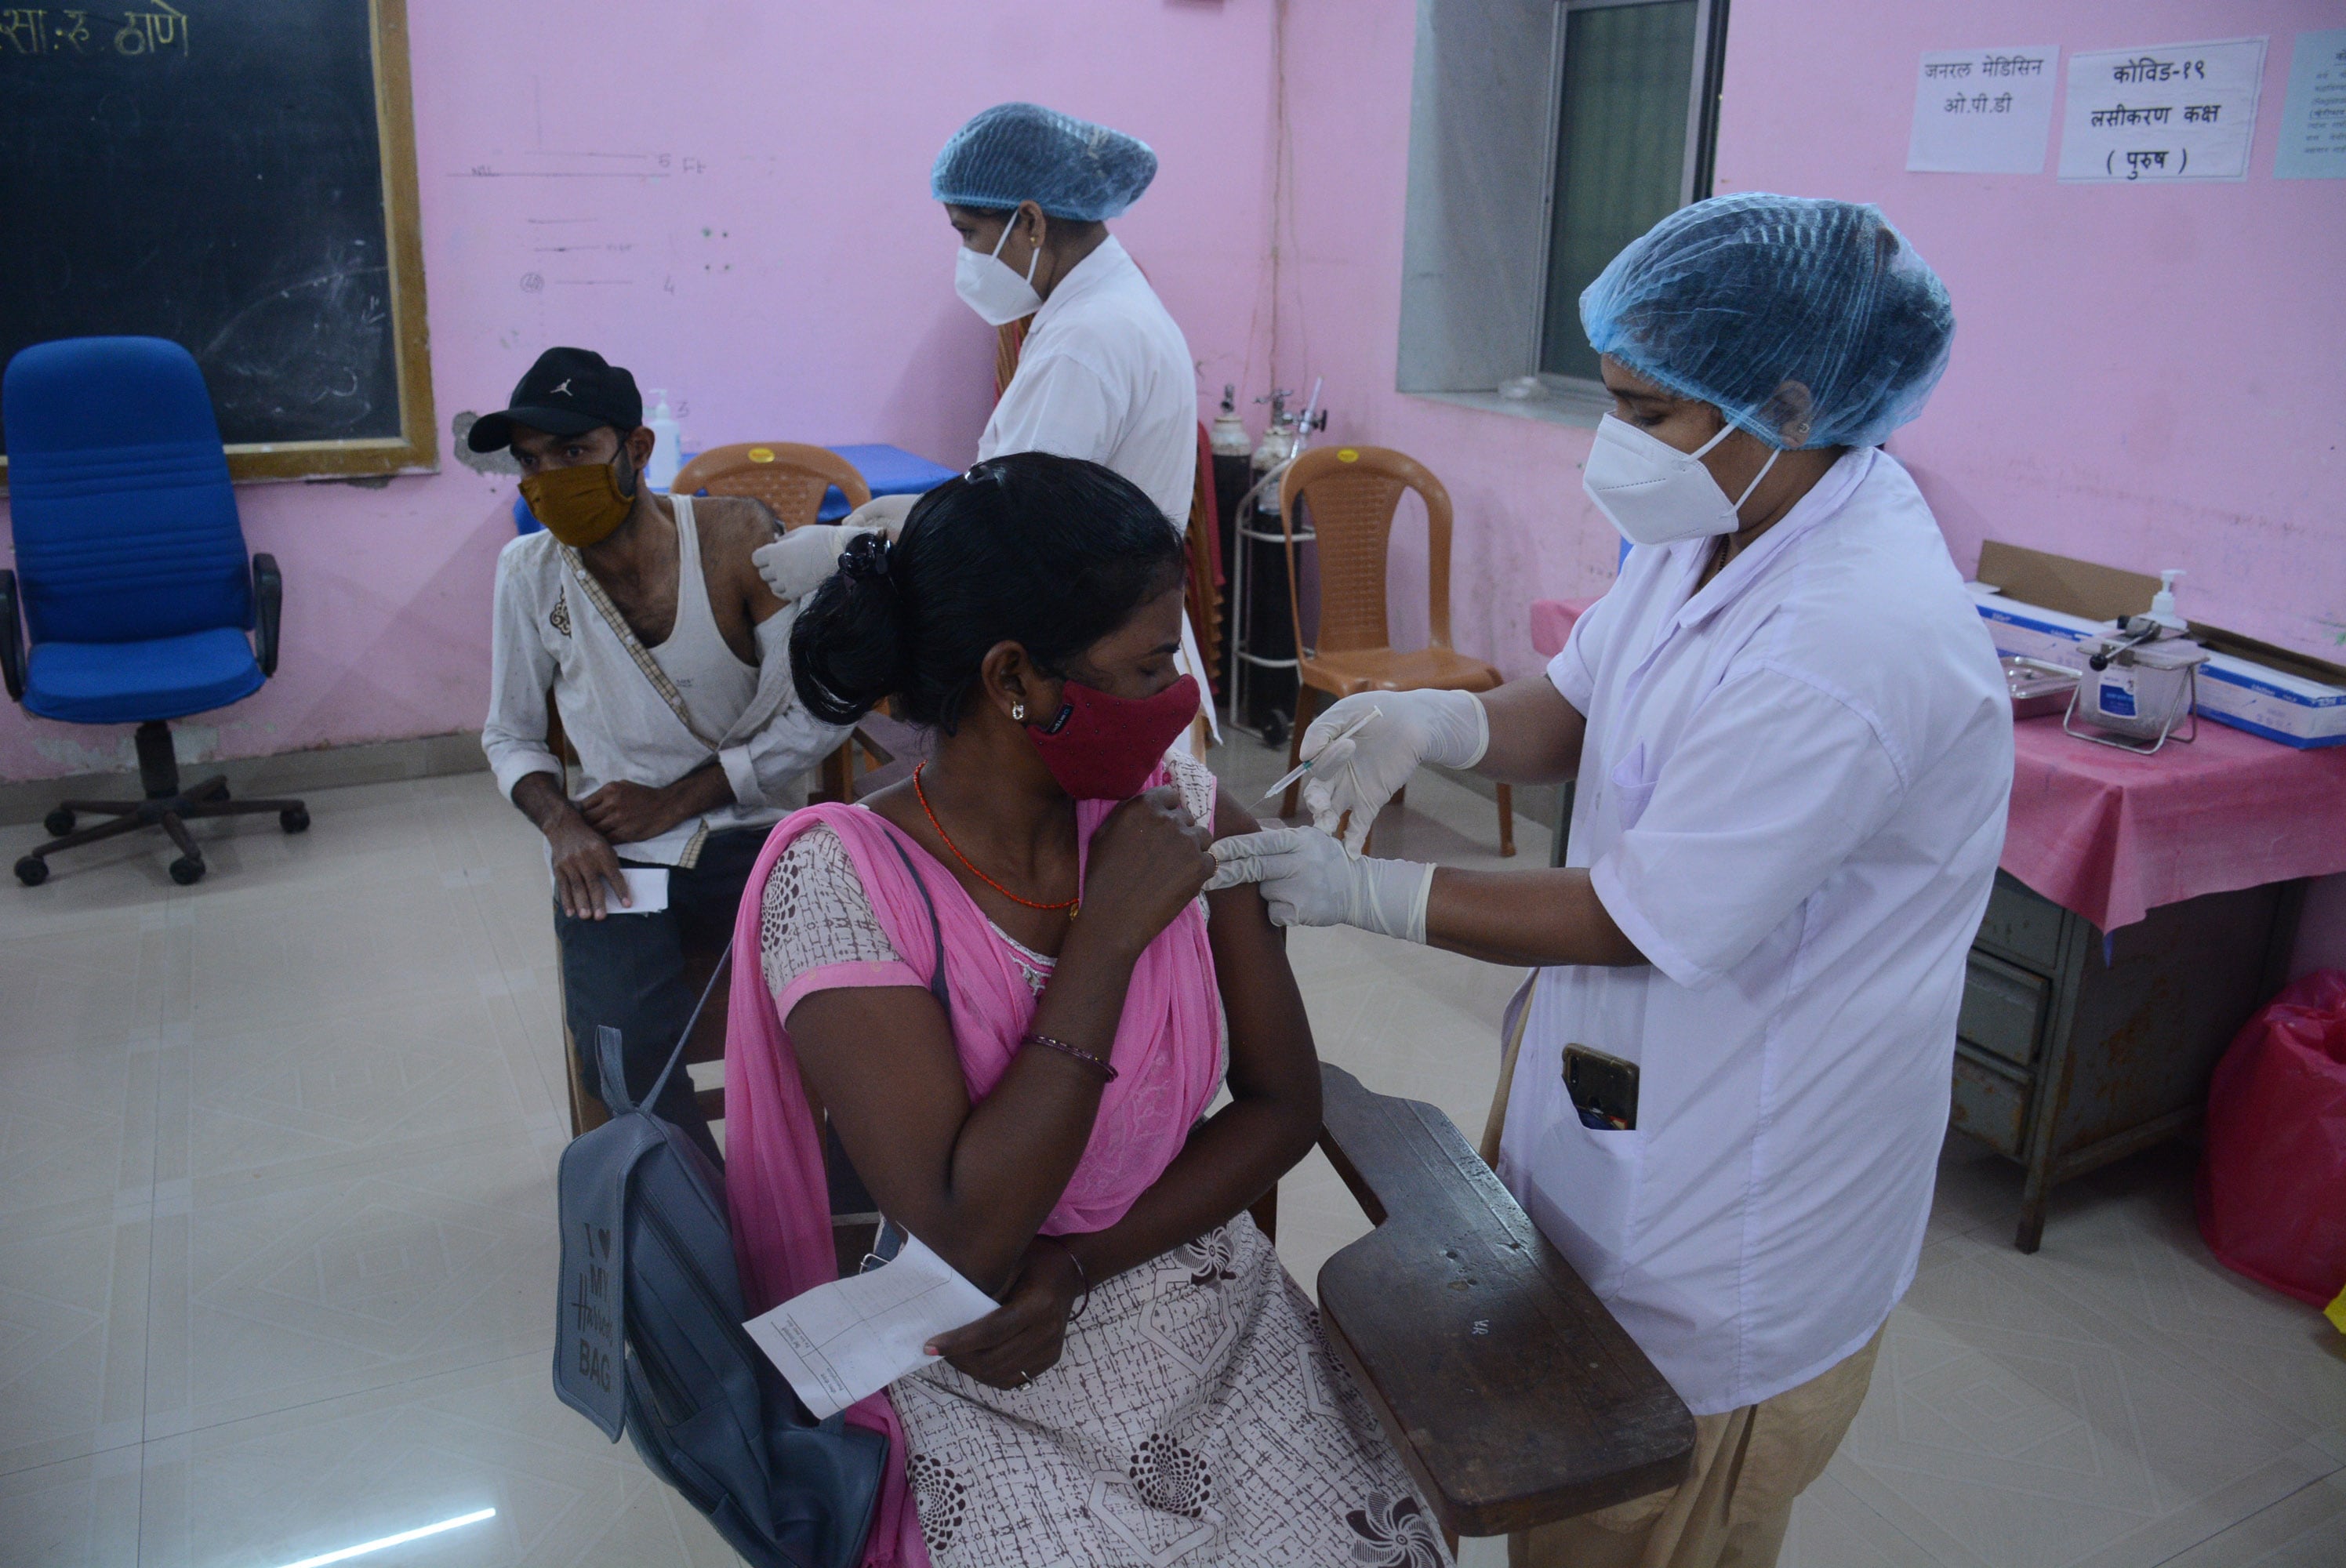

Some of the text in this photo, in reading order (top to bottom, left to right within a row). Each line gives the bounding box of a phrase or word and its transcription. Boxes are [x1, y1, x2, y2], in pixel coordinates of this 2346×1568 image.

[114, 0, 190, 56] ठाणे
[1924, 54, 2044, 79] जनरल मेडिसिन
[2112, 56, 2206, 83] कोविड-१९
[1944, 91, 2014, 114] ओ.पी.डी
[2090, 103, 2222, 127] लसीकरण कक्ष
[2126, 151, 2170, 180] पुरुष
[584, 1222, 595, 1258] I
[589, 1263, 609, 1303] MY
[579, 1338, 611, 1394] BAG
